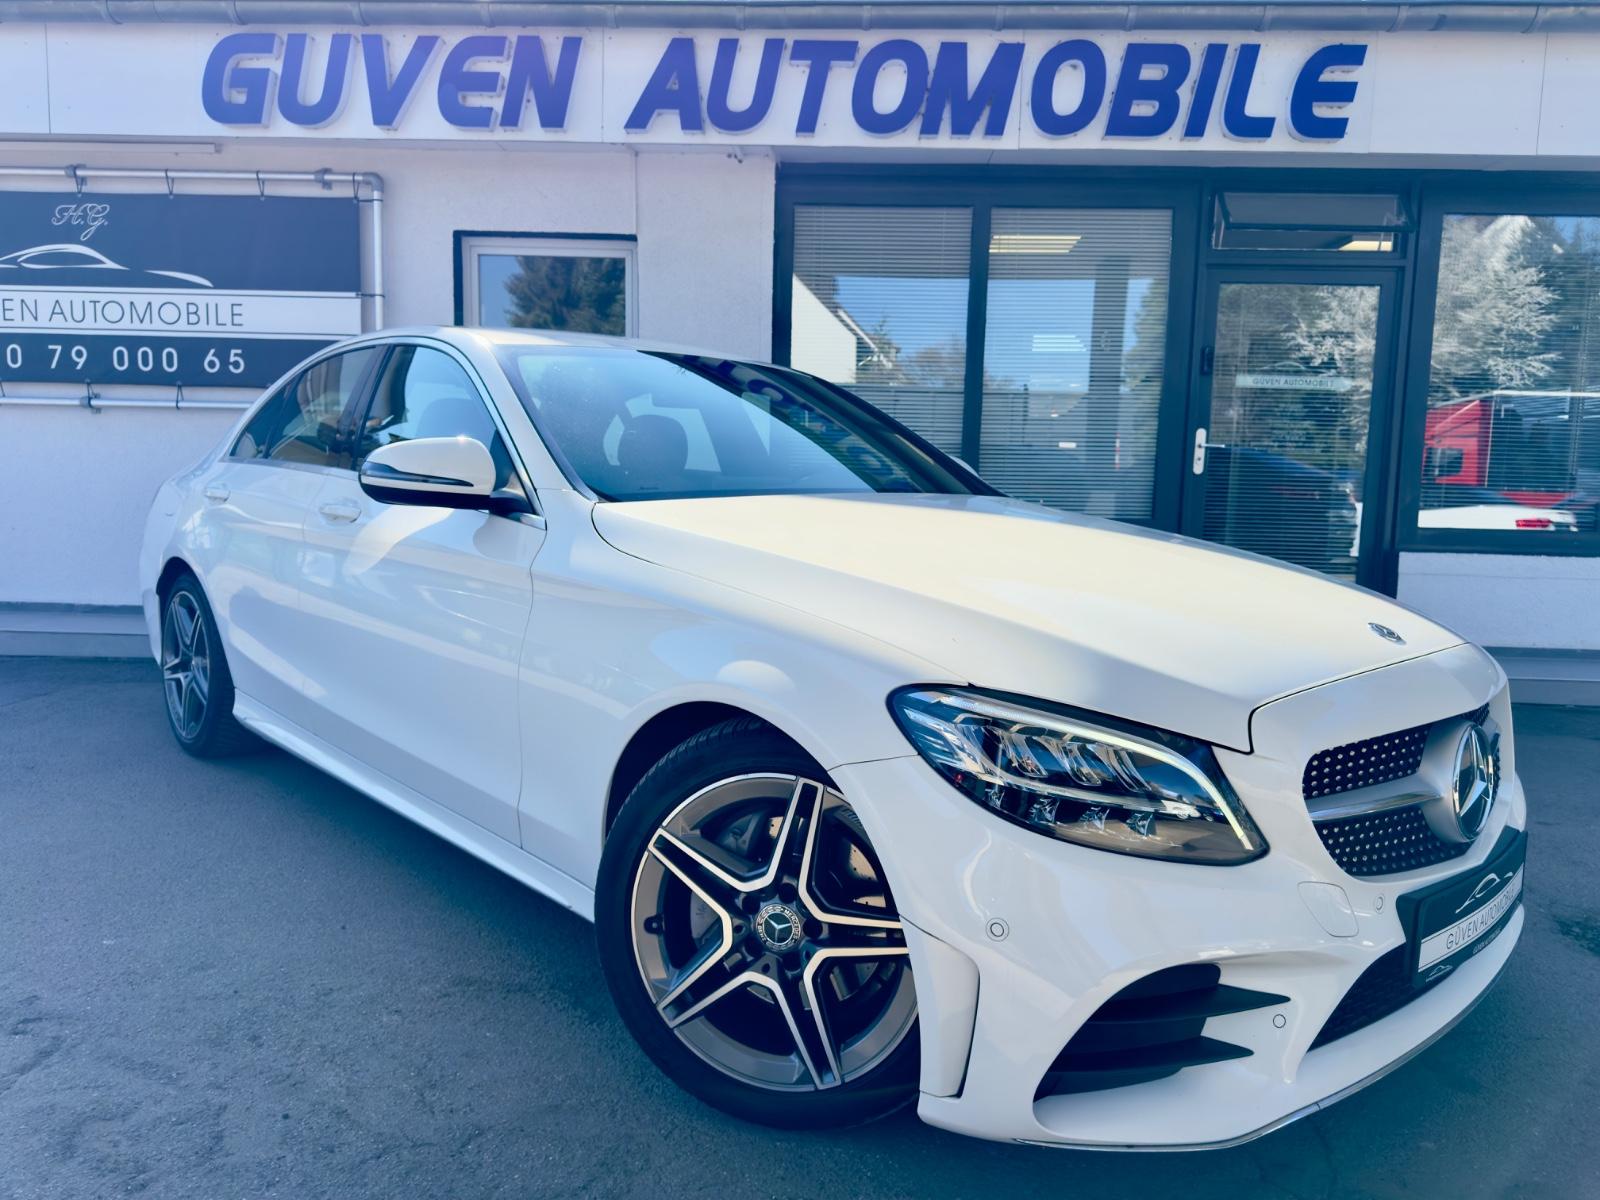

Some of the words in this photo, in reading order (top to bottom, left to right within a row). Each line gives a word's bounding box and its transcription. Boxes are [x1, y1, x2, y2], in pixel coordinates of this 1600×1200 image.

[624, 38, 1368, 142] AUTOMOBILE
[48, 299, 244, 327] AUTOMOBILE
[48, 345, 88, 370] 79
[112, 346, 179, 372] 000
[203, 348, 246, 374] 65
